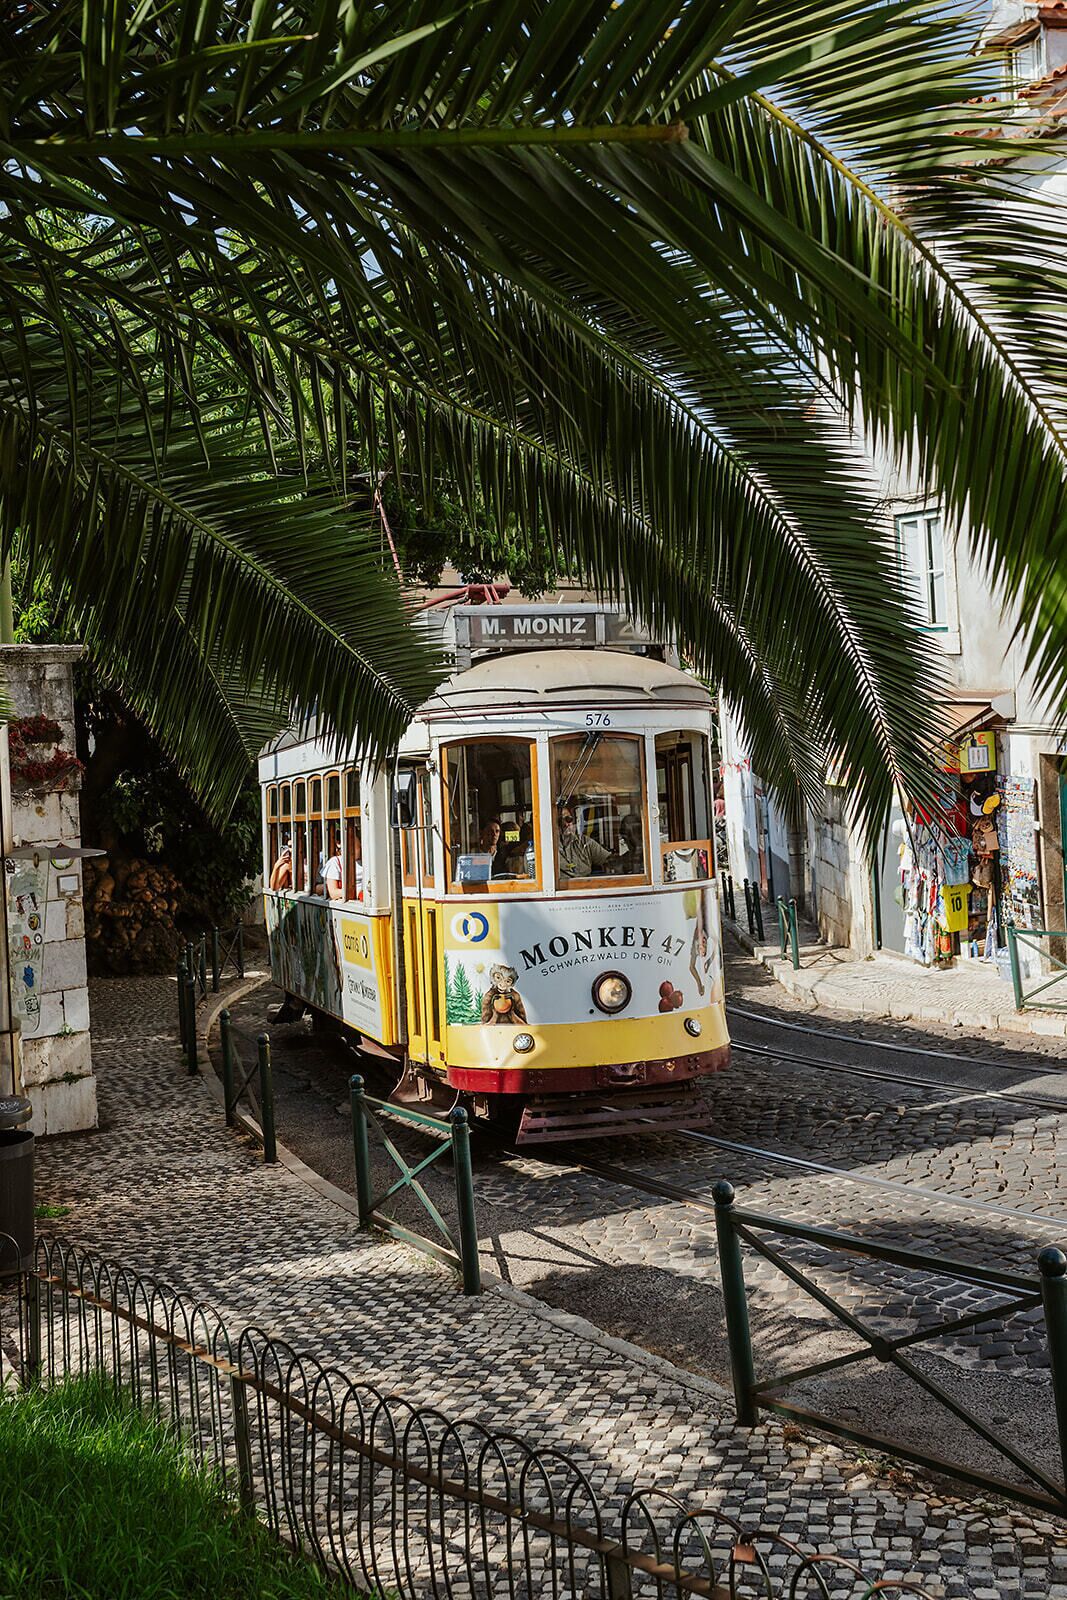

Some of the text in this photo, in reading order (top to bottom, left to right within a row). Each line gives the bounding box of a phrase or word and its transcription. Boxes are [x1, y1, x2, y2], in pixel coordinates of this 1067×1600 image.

[481, 617, 587, 635] M. MONIZ
[585, 713, 611, 727] 576
[951, 896, 963, 912] 10
[518, 926, 687, 970] MONKEY 47
[541, 952, 673, 977] SCHWARZWALD DRY GIN
